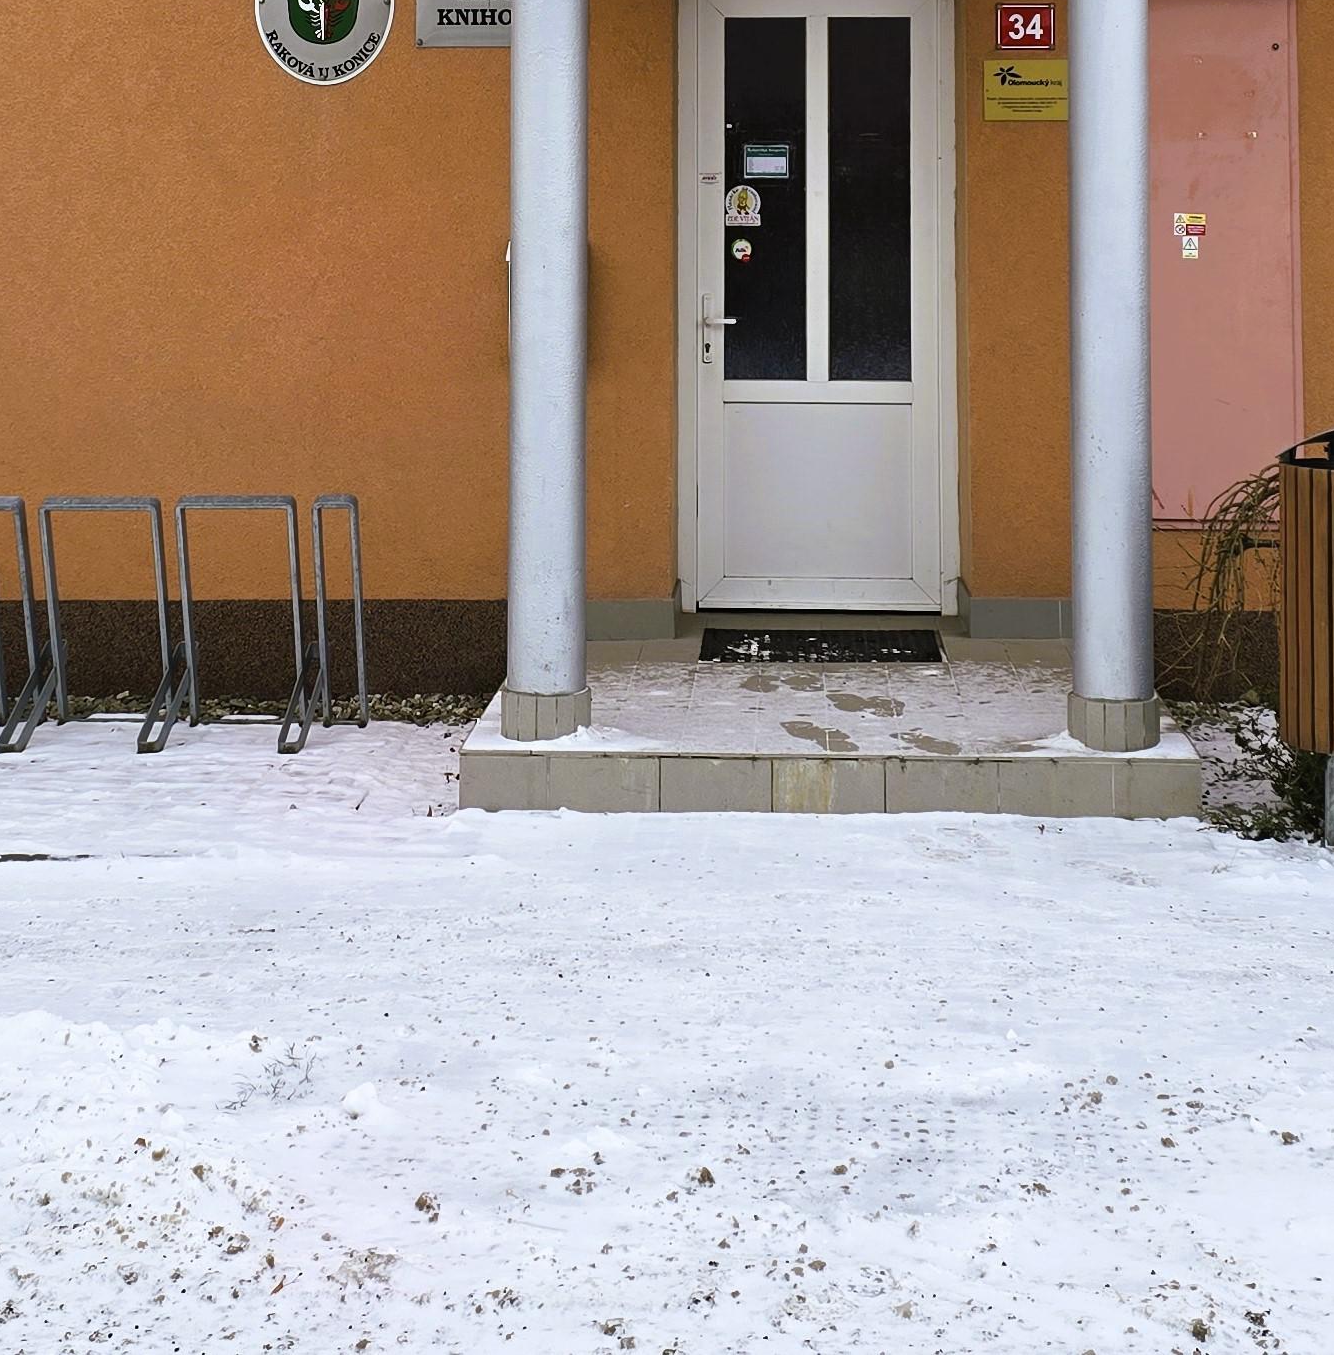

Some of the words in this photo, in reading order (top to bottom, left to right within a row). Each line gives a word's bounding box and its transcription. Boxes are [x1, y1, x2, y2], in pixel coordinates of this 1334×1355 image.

[437, 9, 511, 26] KNIHO
[1008, 13, 1044, 40] 34
[266, 29, 315, 78] RAKOVÁ
[332, 32, 380, 78] KONICE
[1007, 78, 1049, 87] Olomoucký
